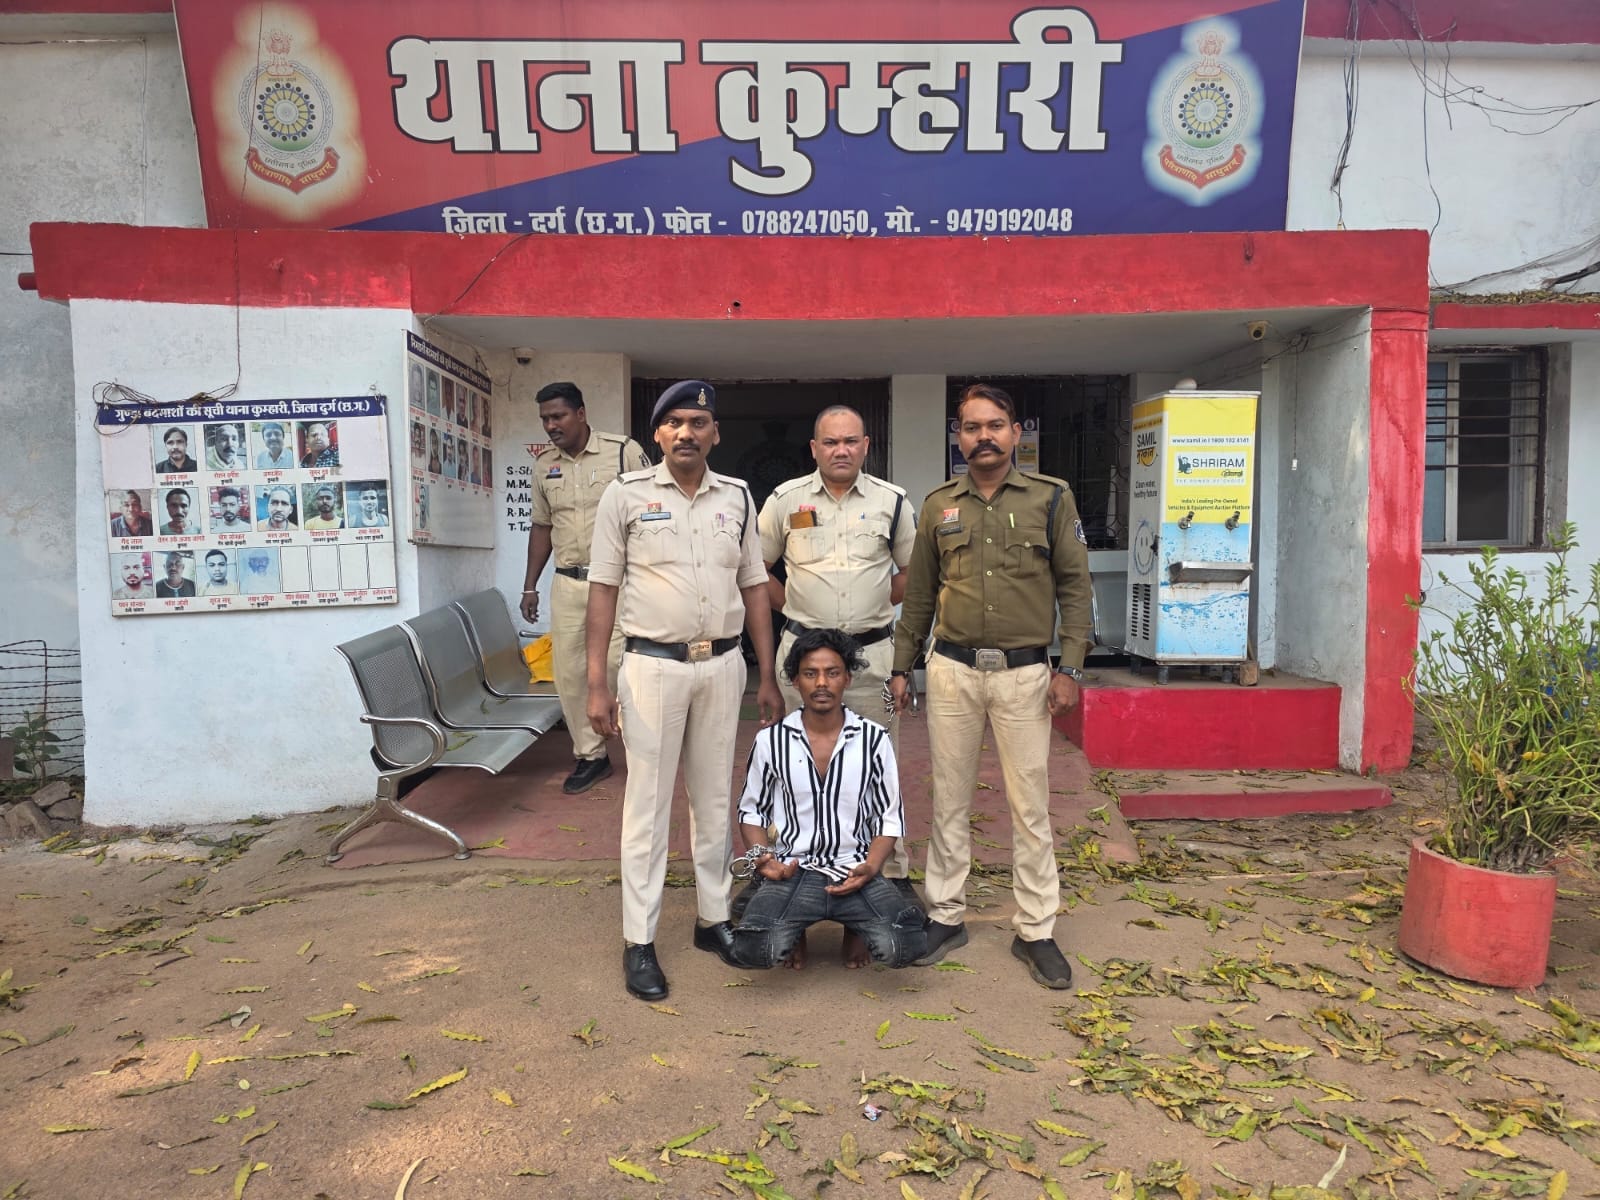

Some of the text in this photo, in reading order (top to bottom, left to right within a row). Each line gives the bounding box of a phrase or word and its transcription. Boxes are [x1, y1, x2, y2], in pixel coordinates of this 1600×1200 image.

[388, 6, 1124, 197] थाना कुम्हारी
[441, 206, 507, 233] जिला
[529, 206, 567, 233] दर्ग
[575, 206, 656, 235] (छ.ग.)
[663, 206, 712, 234] फोन
[946, 208, 1073, 233] 9479192048
[203, 402, 224, 419] सूची
[226, 404, 250, 416] थाना
[292, 400, 317, 414] जिला
[319, 399, 337, 415] दुर्ग
[1137, 432, 1157, 448] SAMIL
[1192, 458, 1245, 468] SHRIRAM
